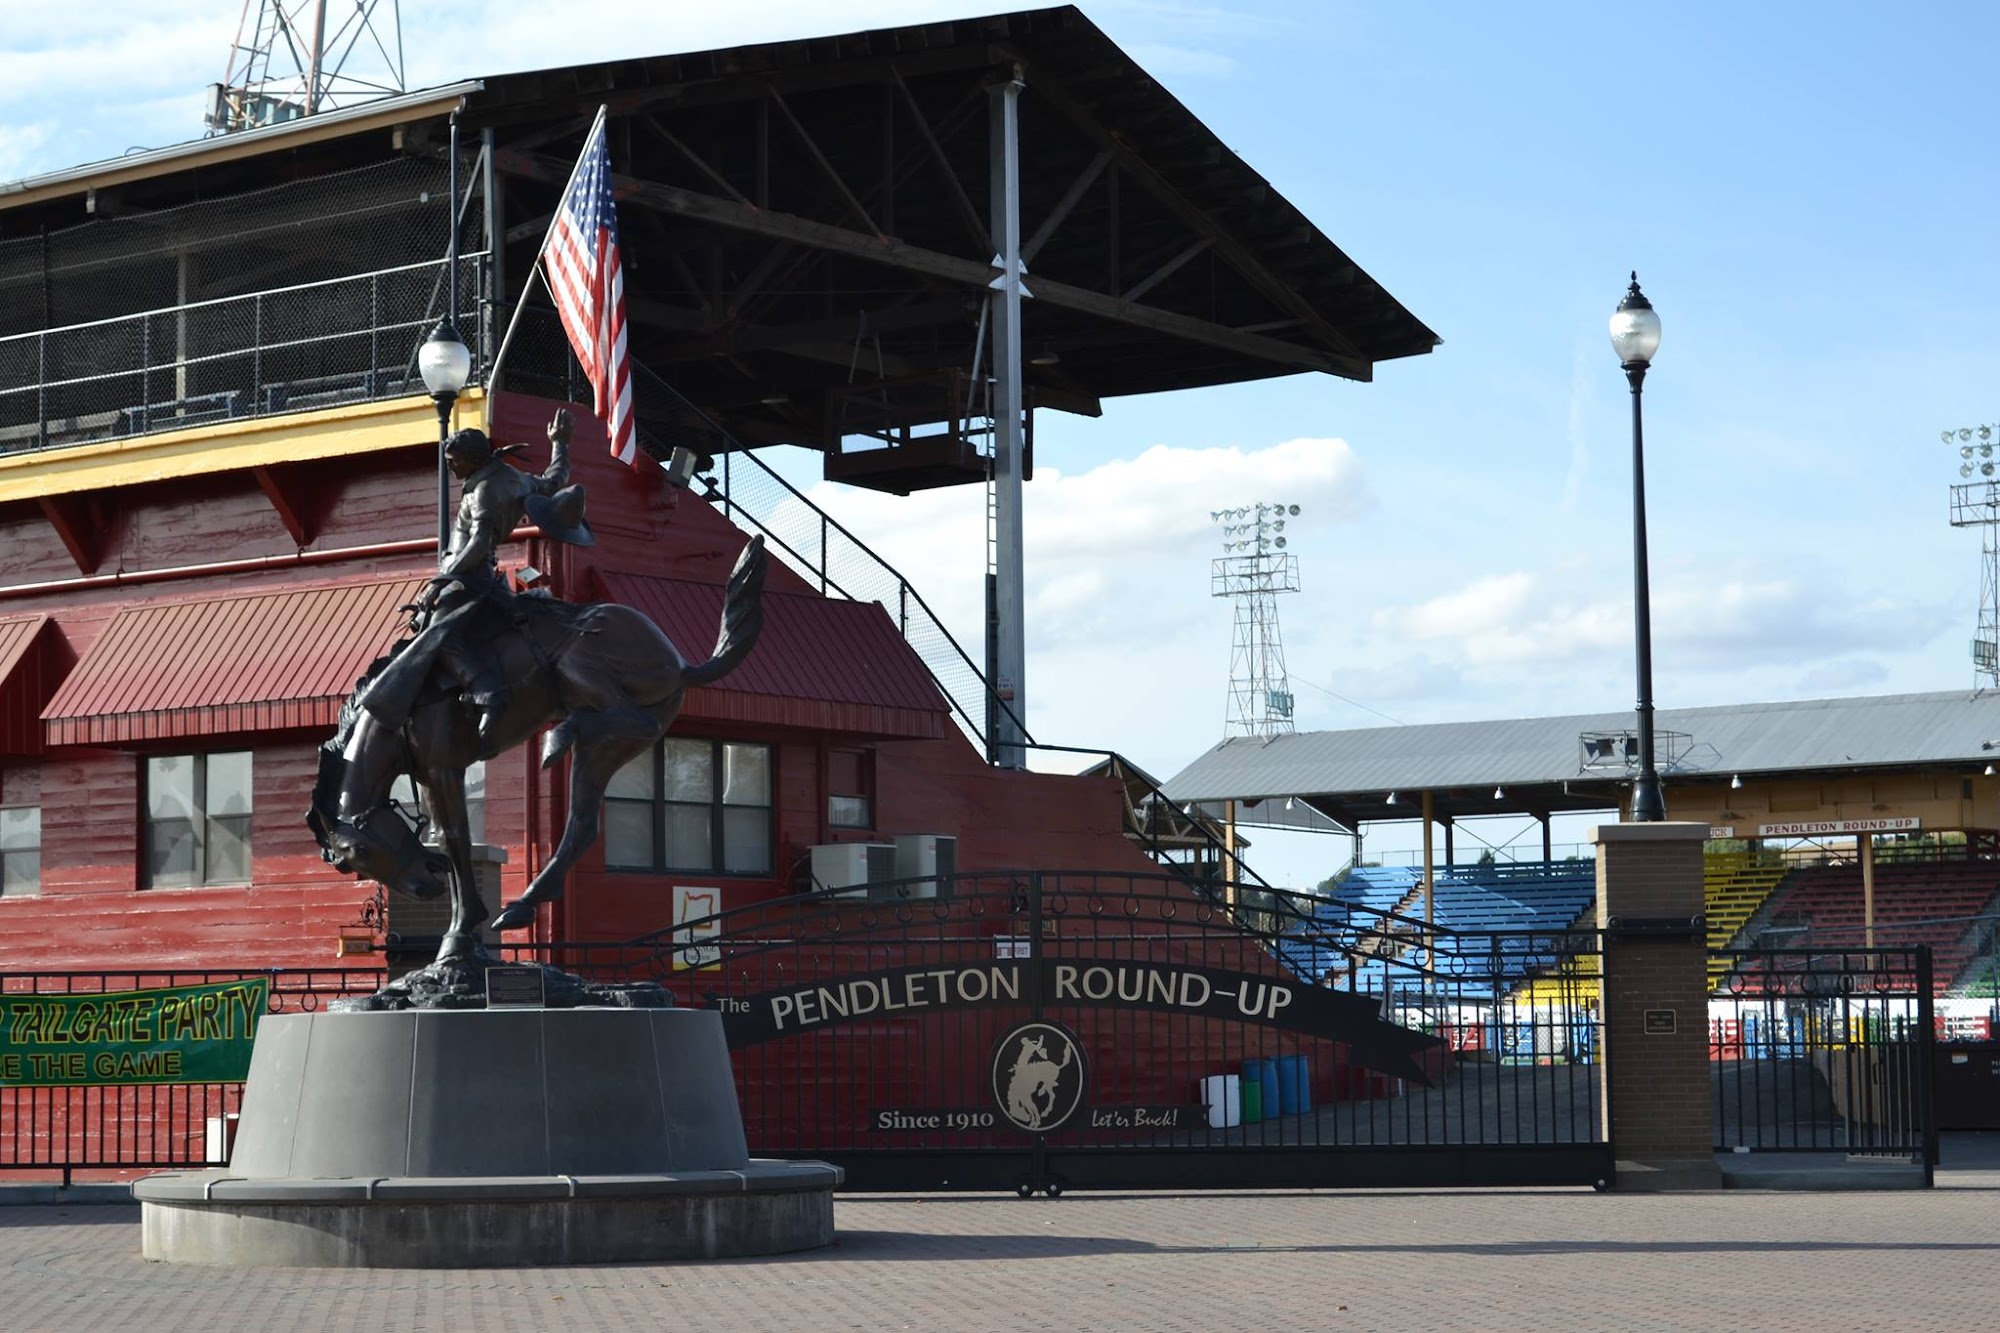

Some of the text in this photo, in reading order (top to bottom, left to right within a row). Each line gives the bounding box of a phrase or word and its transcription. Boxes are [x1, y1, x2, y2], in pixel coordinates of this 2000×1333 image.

[1765, 818, 1914, 834] PENDLETON ROUND-UP
[717, 965, 1293, 1030] The PENDLETON ROUND-UP
[10, 986, 262, 1044] TAILGATE PARTY
[28, 1053, 86, 1079] THE
[93, 1051, 183, 1078] GAME
[878, 1110, 994, 1129] Since 1910
[1091, 1108, 1179, 1128] Let'er Buck!
